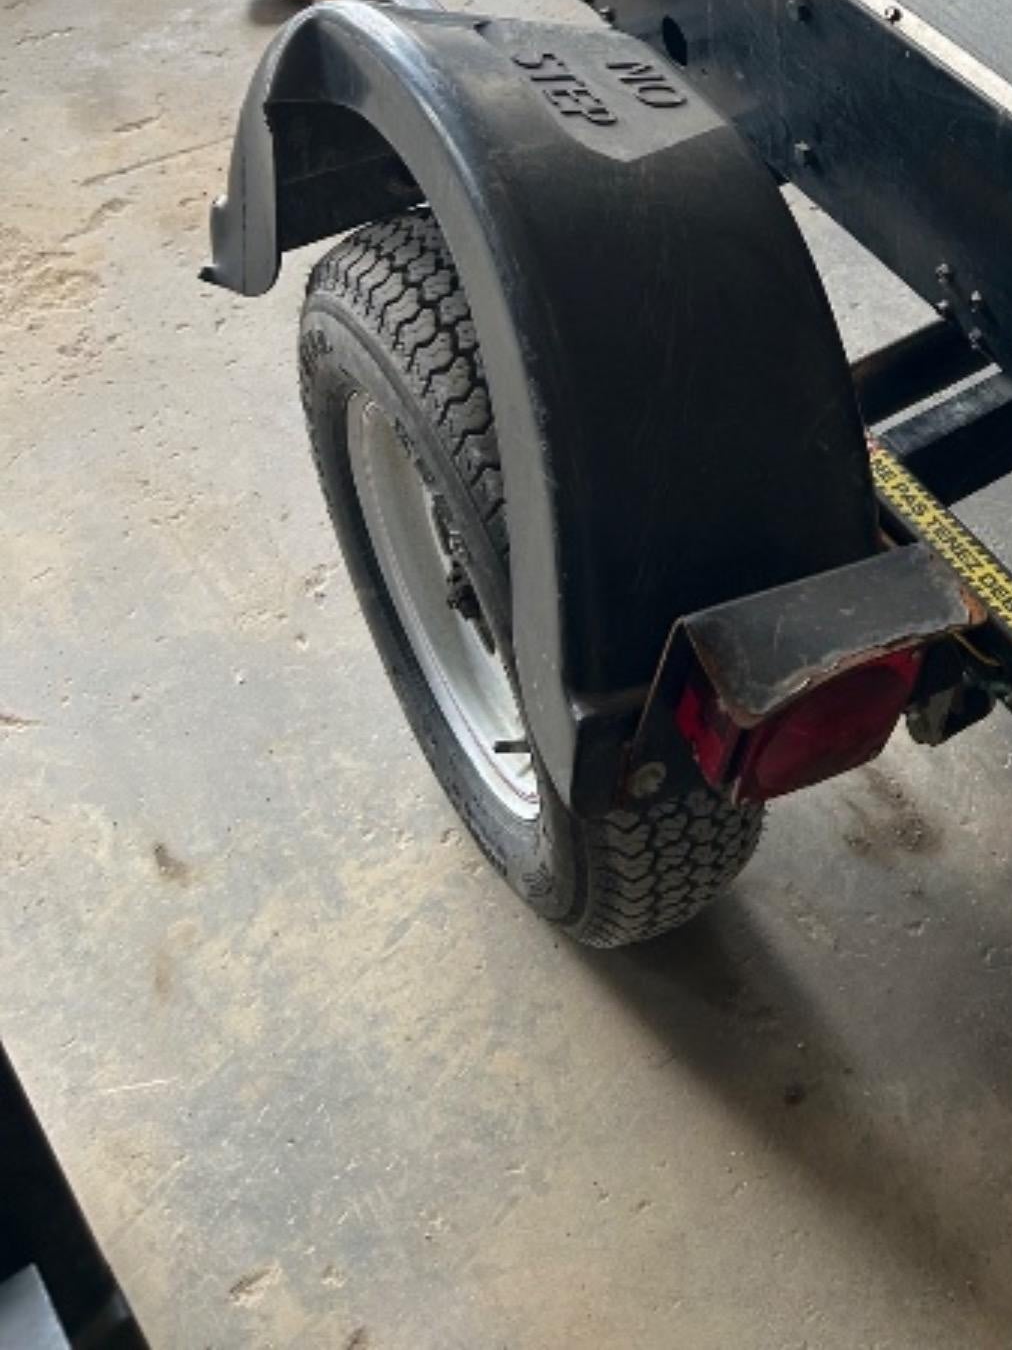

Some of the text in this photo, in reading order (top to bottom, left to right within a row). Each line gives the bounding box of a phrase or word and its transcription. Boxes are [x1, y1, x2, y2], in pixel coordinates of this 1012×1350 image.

[510, 52, 620, 127] STEP
[605, 61, 689, 109] NO
[891, 482, 928, 518] PAS
[925, 513, 985, 574] TENEZ
